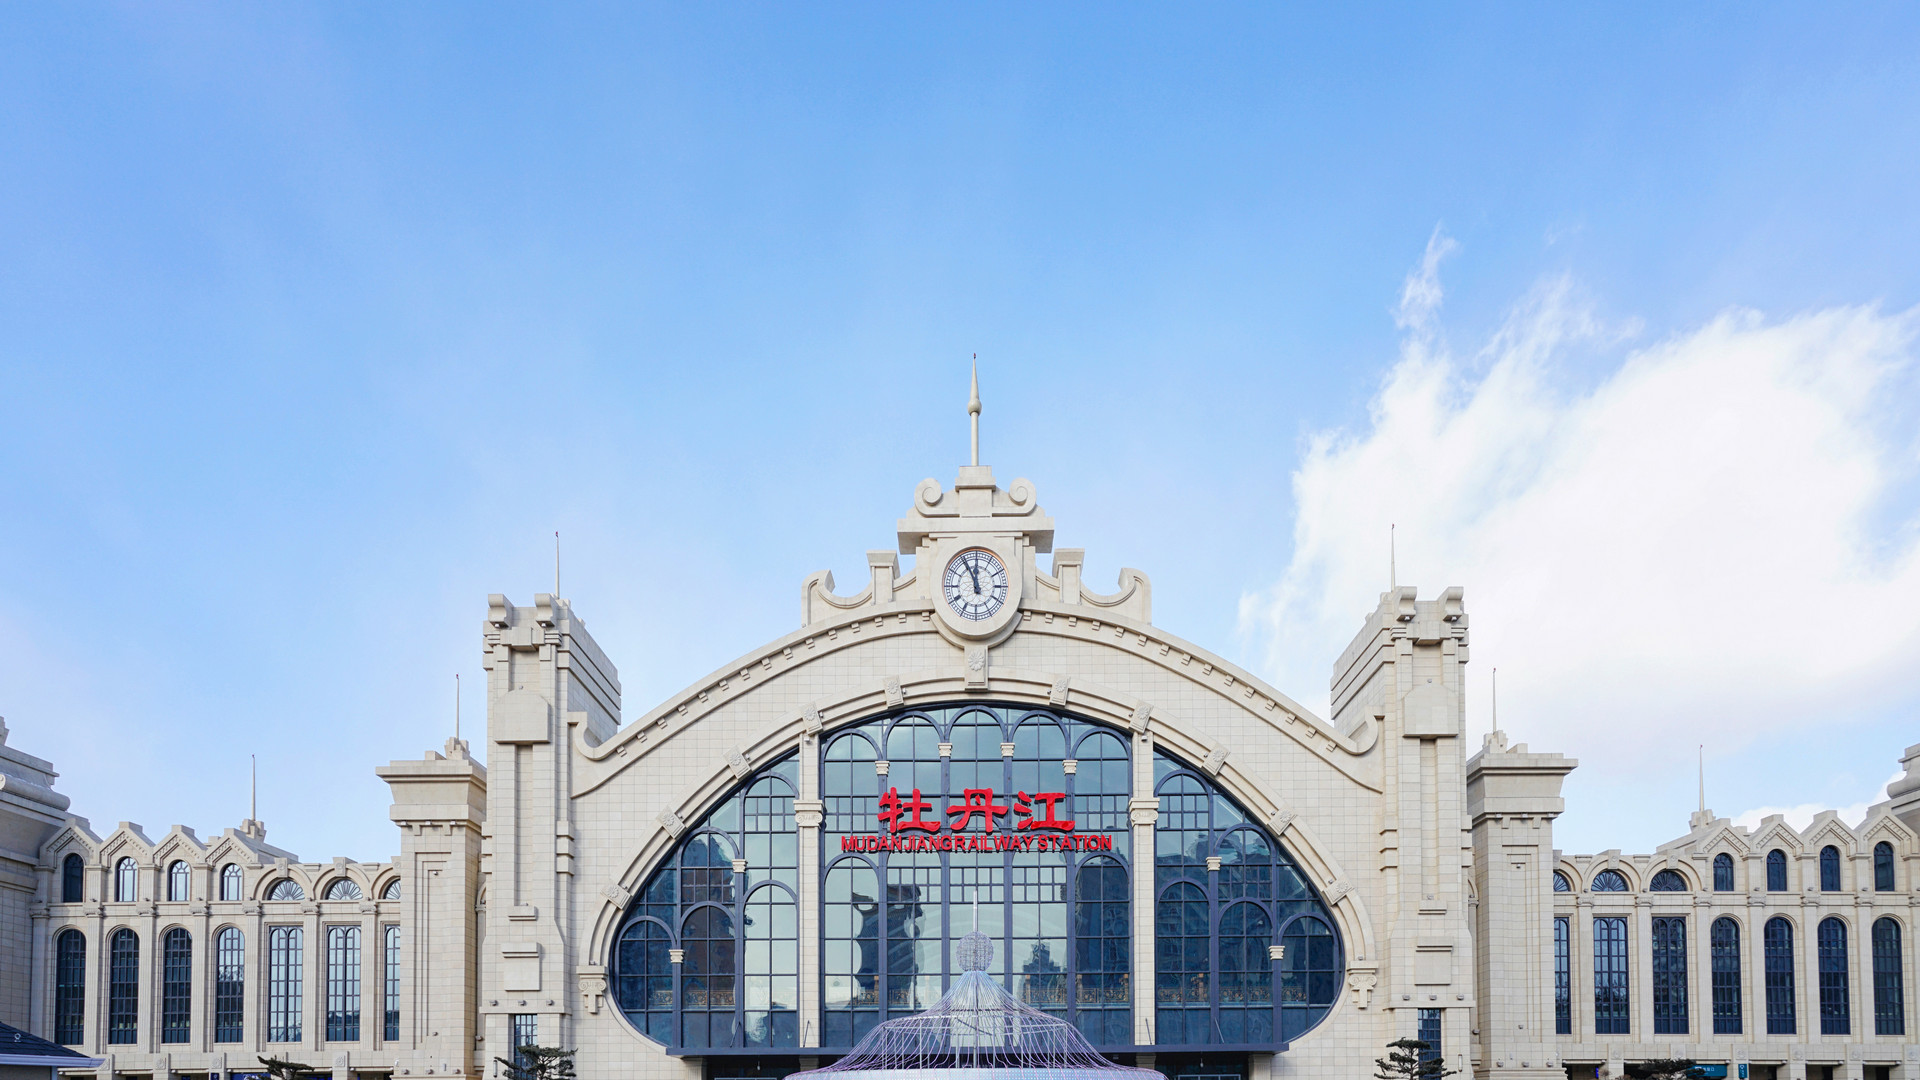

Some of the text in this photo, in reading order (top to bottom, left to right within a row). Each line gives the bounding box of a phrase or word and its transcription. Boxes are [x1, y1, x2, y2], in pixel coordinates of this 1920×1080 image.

[877, 786, 1076, 834] 牡丹江
[1037, 834, 1113, 852] STATION
